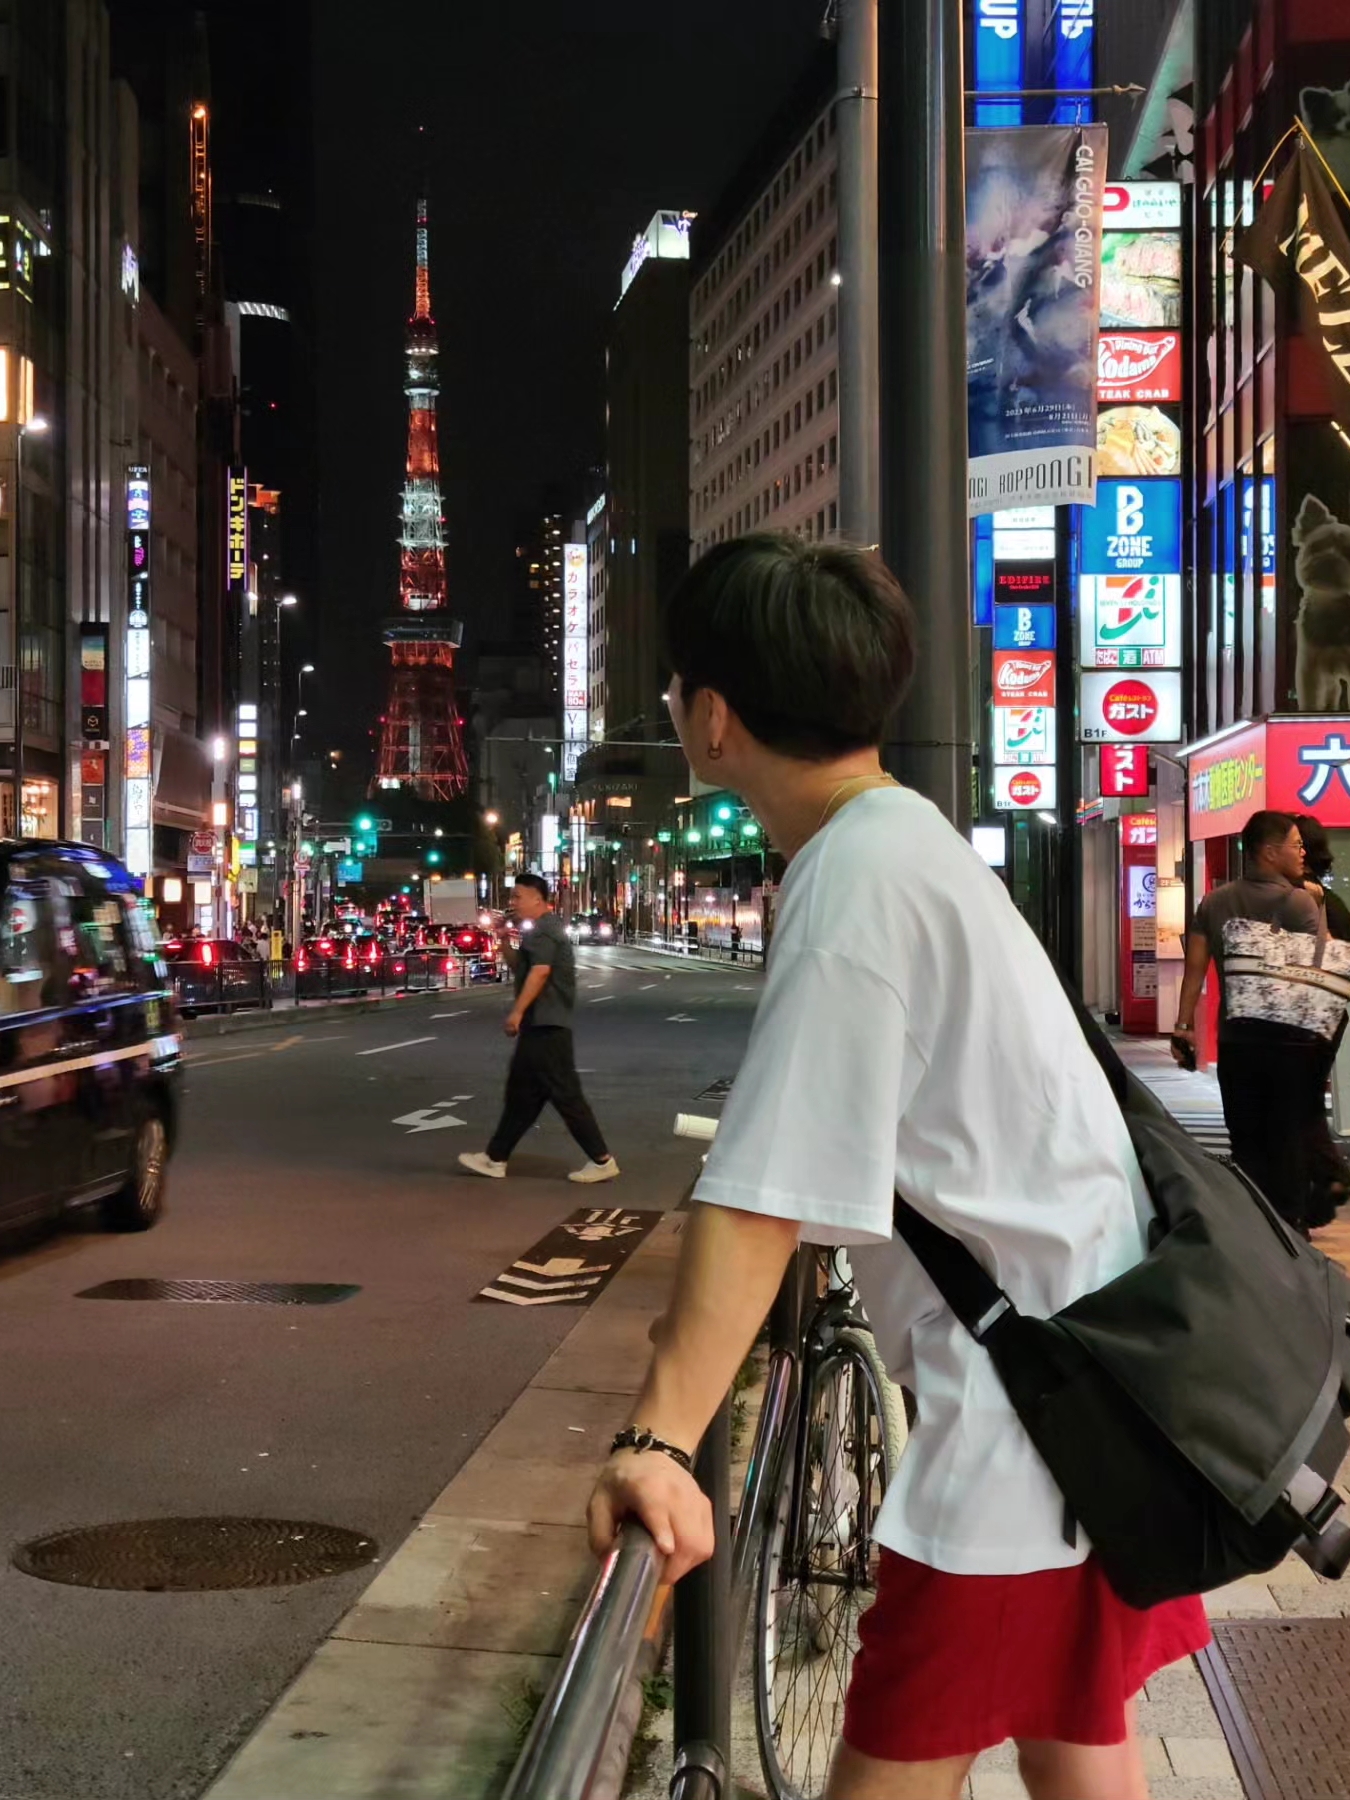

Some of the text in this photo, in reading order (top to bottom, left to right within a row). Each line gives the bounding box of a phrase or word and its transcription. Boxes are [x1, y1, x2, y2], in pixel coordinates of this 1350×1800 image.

[1075, 145, 1094, 289] CAI GUO-QIANG
[1098, 389, 1131, 399] TEAK
[1000, 456, 1092, 495] ROPPONGI
[1117, 485, 1144, 535] B
[230, 478, 245, 579] ドン・キホーテ
[1107, 536, 1153, 557] ZONE
[1116, 558, 1144, 569] GROUP
[566, 572, 579, 687] カラオケ パセラ
[1018, 608, 1032, 631] B
[1143, 649, 1164, 665] ATM
[1109, 703, 1155, 719] ガスト
[1084, 729, 1107, 738] B1F
[1114, 744, 1134, 791] スト
[1299, 735, 1350, 806] 六
